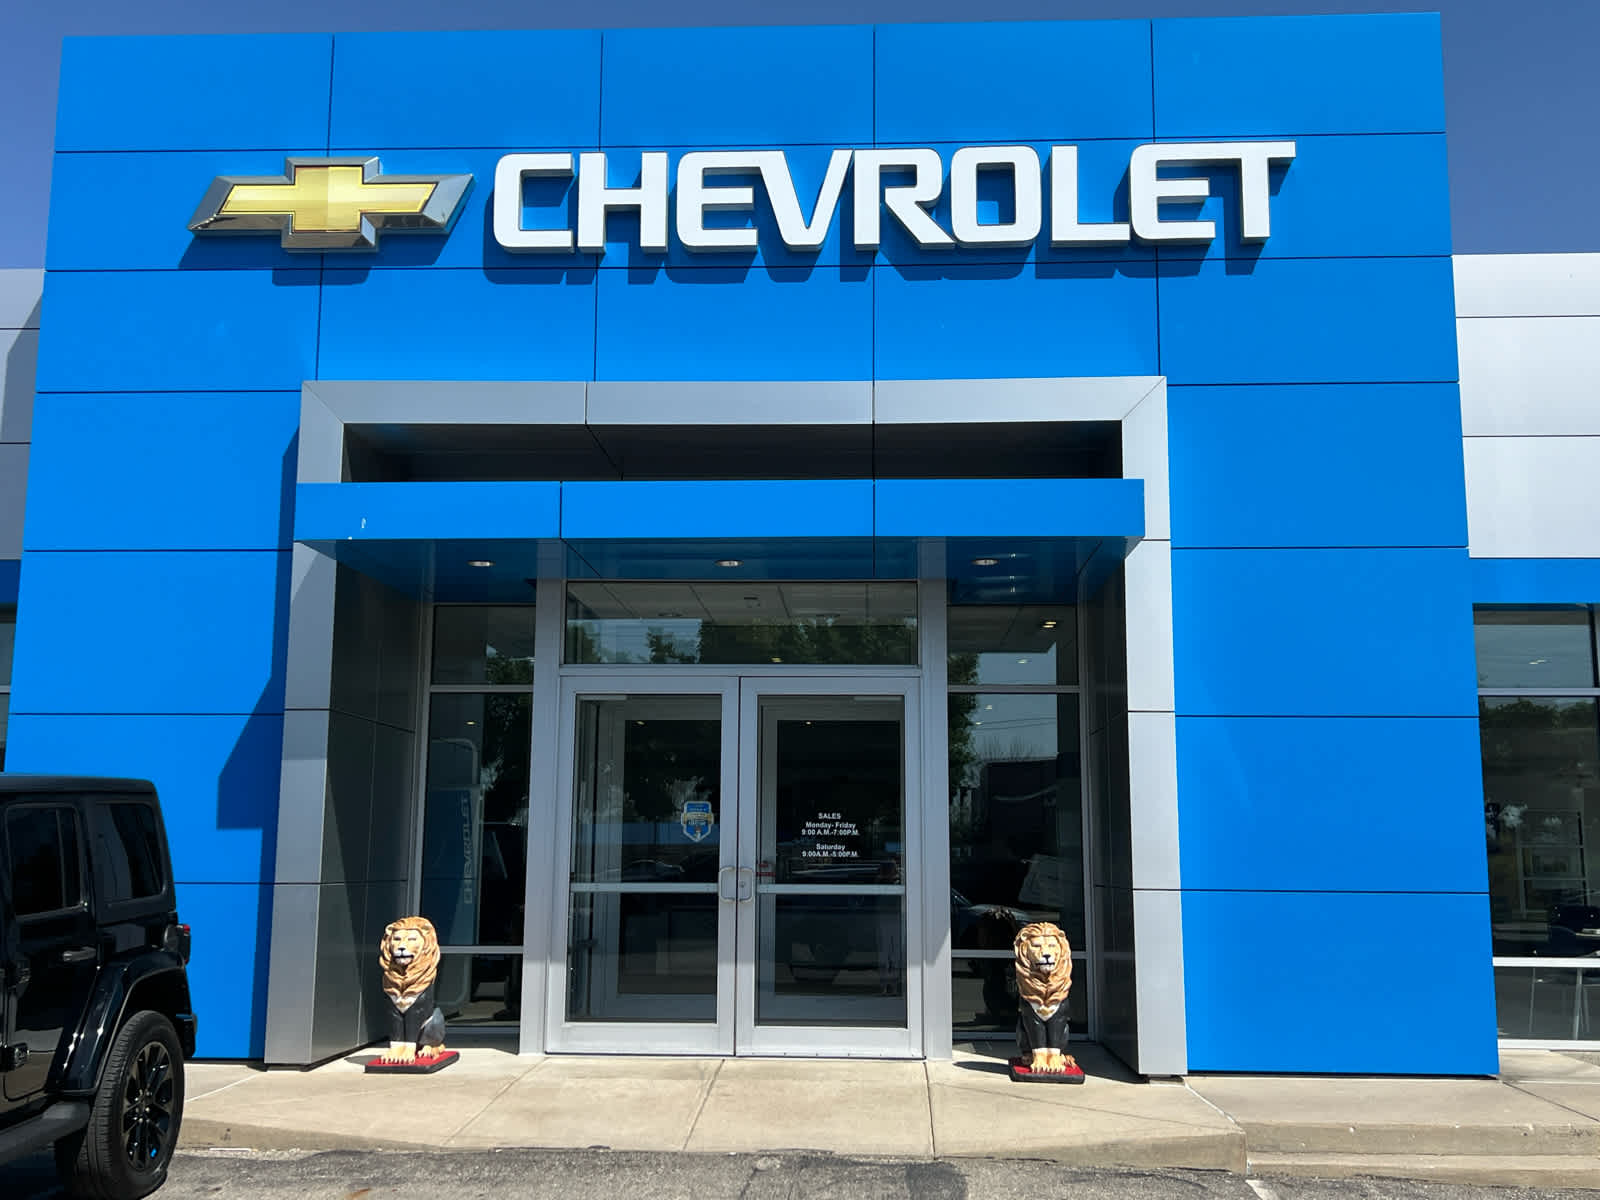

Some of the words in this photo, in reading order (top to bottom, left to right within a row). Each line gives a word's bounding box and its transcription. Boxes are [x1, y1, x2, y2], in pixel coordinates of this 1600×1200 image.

[493, 140, 1297, 252] CHEVROLET
[818, 812, 842, 820] SALES
[835, 821, 857, 830] Friday
[816, 843, 846, 851] Saturday
